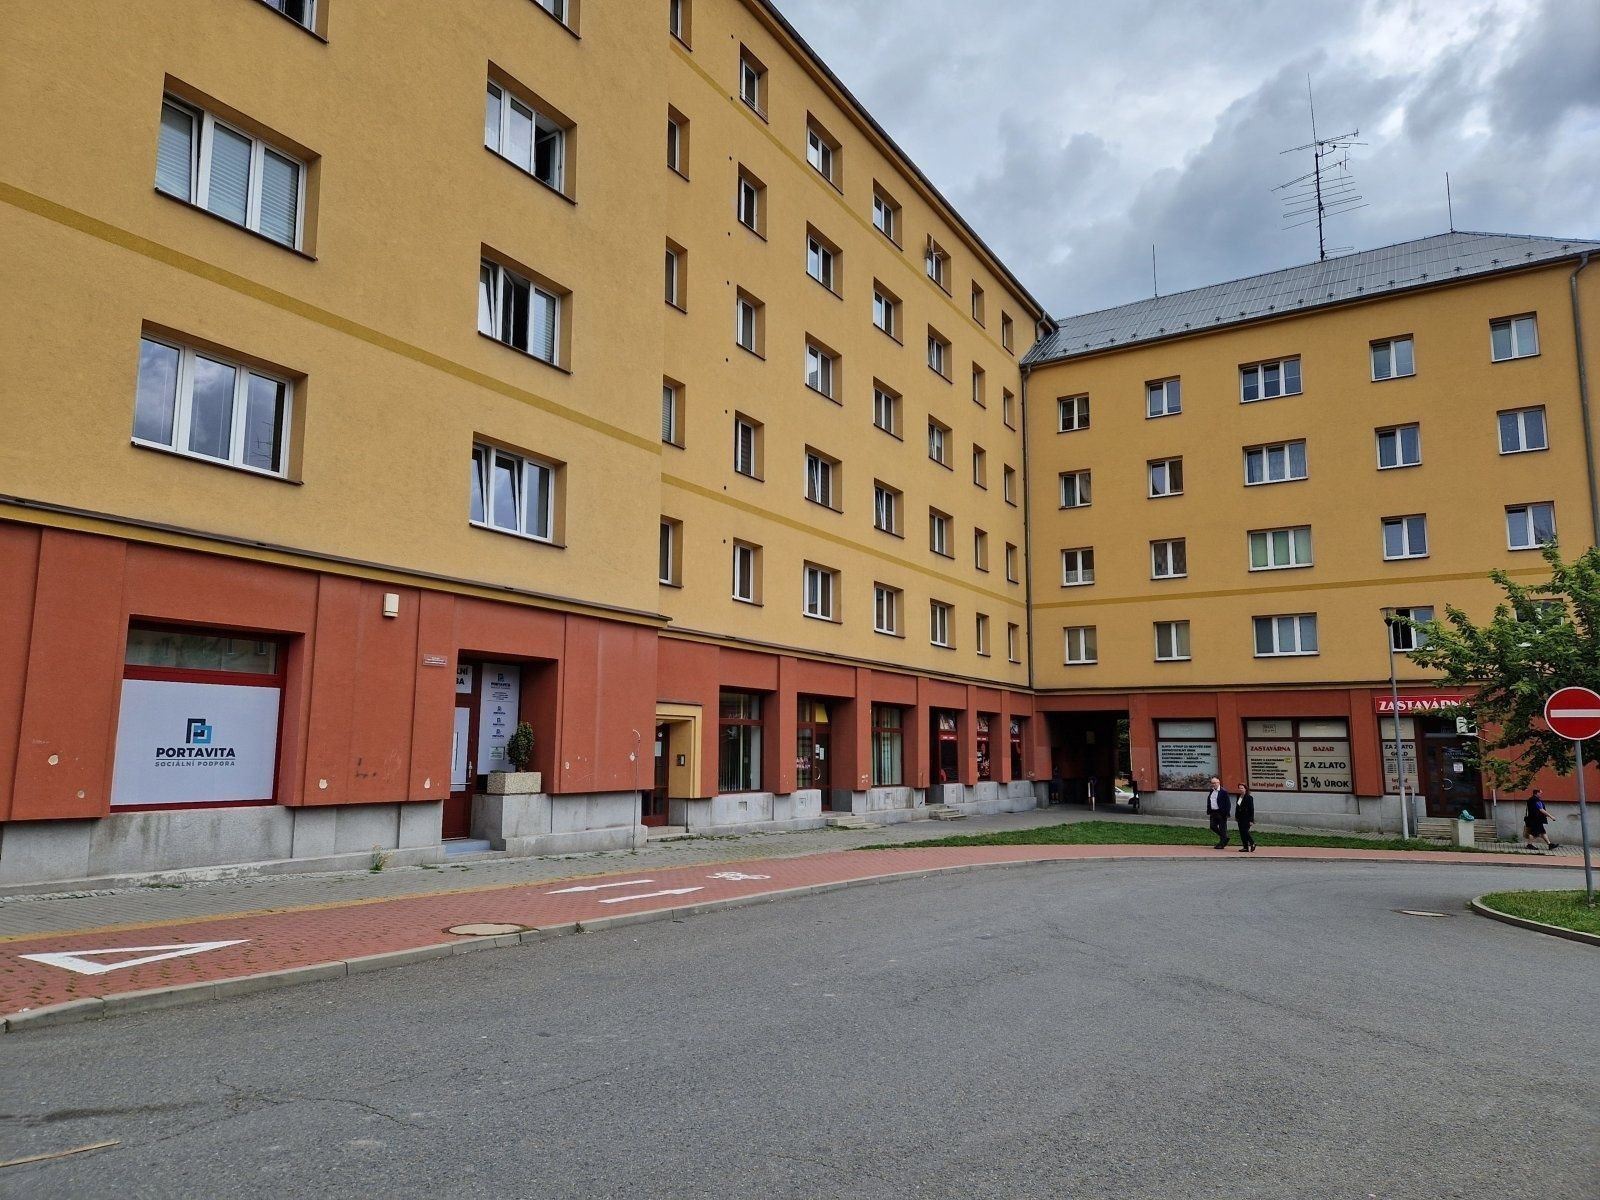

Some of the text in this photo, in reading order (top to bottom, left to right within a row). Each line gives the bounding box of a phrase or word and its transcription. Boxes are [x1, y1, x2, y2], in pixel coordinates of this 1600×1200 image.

[155, 747, 236, 758] PORTAVITA
[1303, 761, 1346, 769] ZA ZLATO
[1302, 776, 1350, 788] 5 % ÚROK
